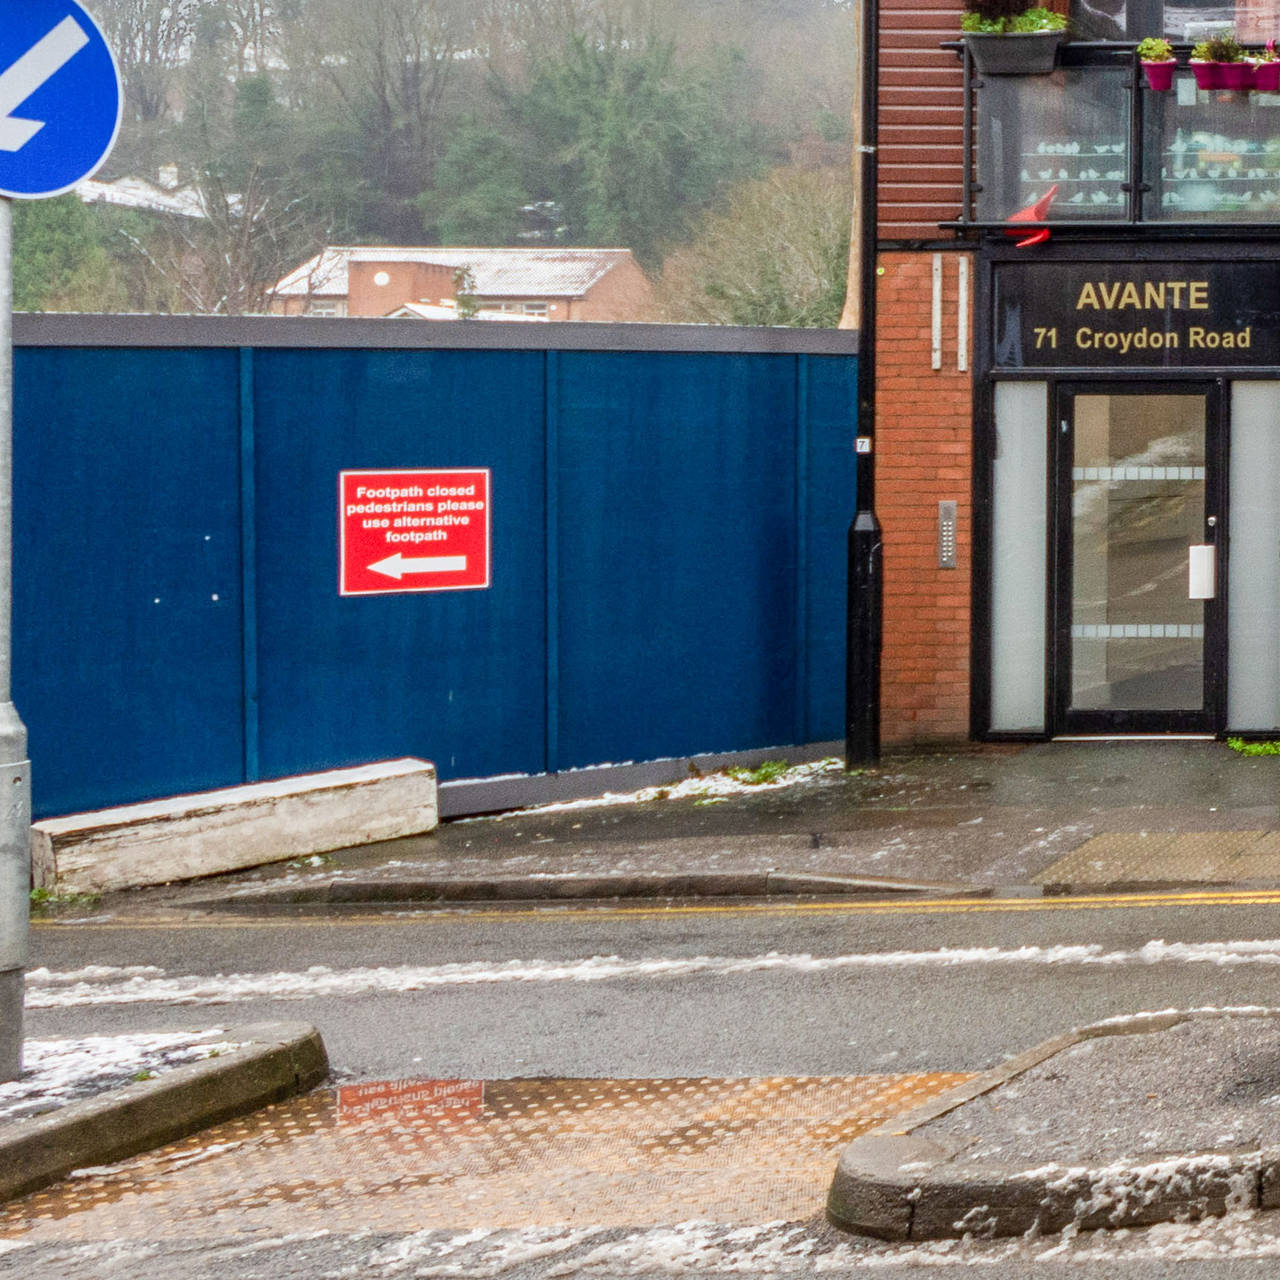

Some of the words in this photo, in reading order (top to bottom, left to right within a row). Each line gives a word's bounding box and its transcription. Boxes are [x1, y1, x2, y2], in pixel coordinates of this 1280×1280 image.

[1076, 282, 1209, 310] AVANTE
[1034, 328, 1058, 349] 71
[1076, 327, 1179, 354] Croydon
[1189, 327, 1251, 348] Road
[356, 486, 423, 499] Footpath
[427, 485, 475, 496] closed
[347, 501, 434, 516] pedestrians
[438, 500, 484, 512] please
[363, 518, 389, 528] use
[394, 515, 470, 527] alternative
[385, 531, 447, 543] footpath
